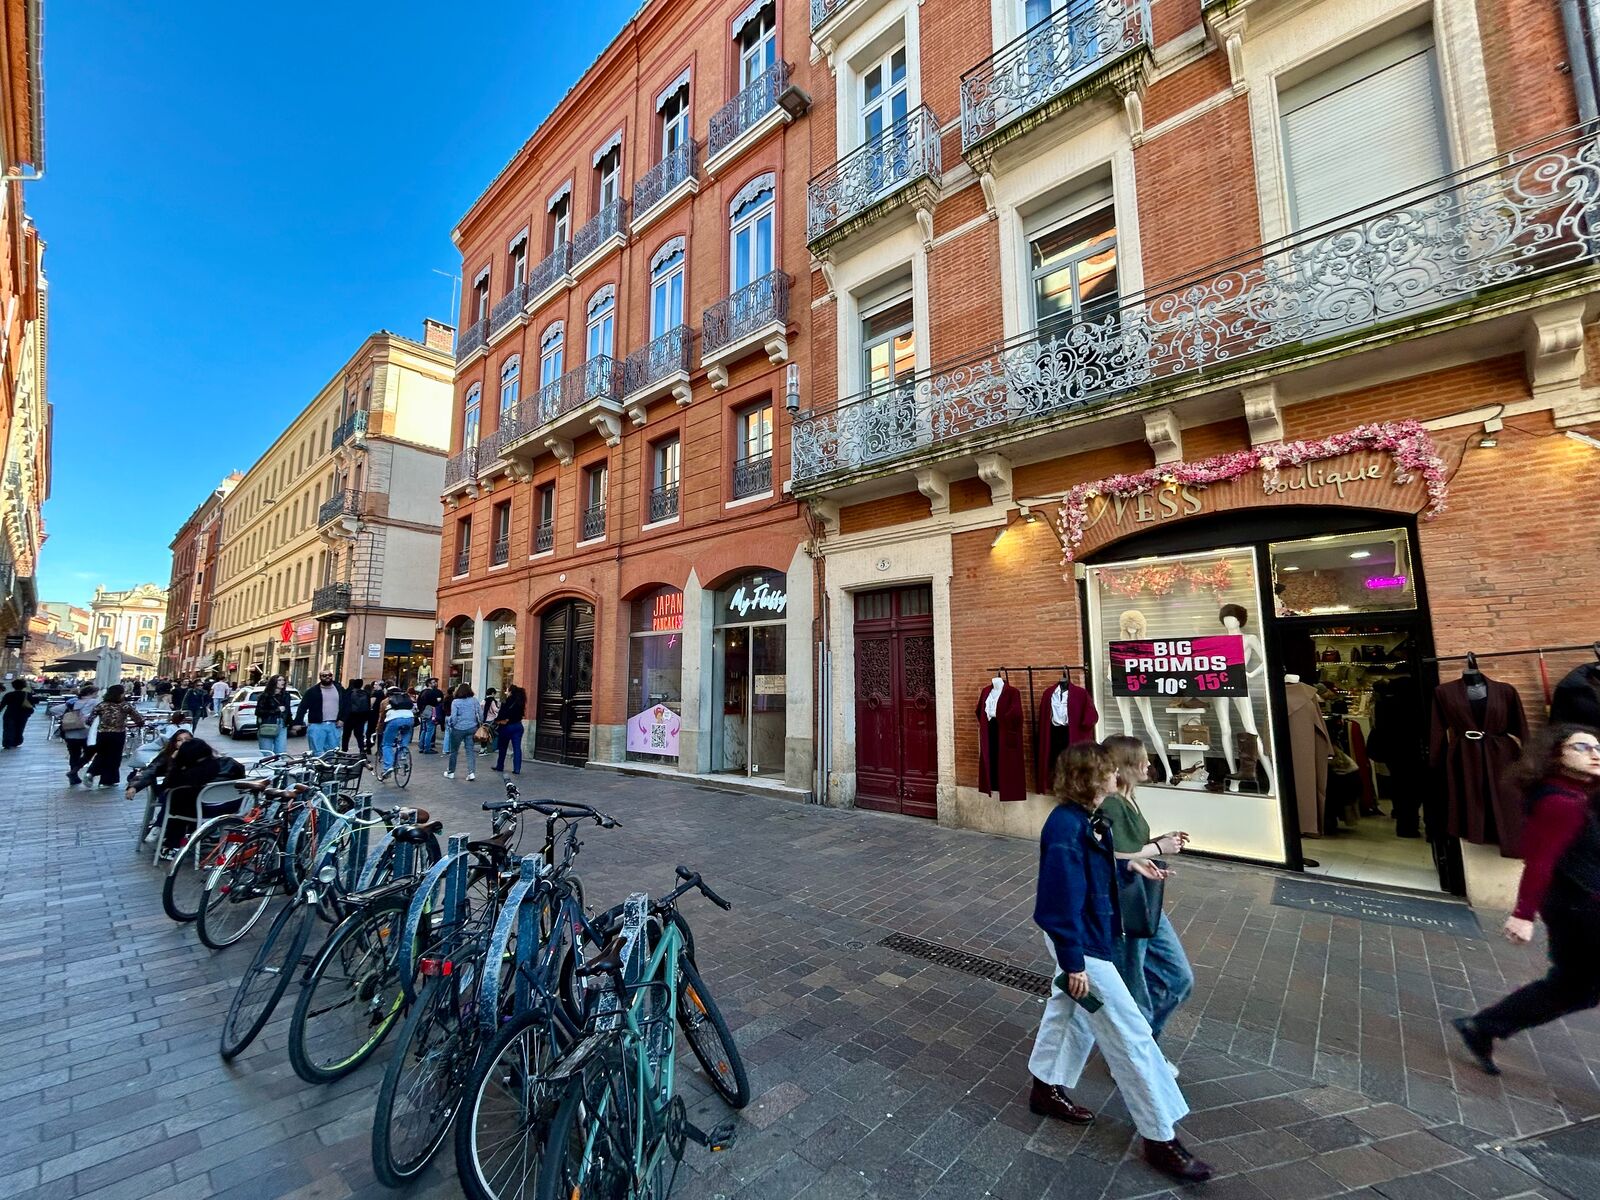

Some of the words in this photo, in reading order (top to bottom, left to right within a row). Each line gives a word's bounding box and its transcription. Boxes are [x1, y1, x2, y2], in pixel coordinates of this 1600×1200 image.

[1081, 487, 1202, 531] NESS
[653, 593, 683, 617] JAPAN
[730, 587, 750, 617] My
[750, 583, 787, 613] Fluffy
[652, 615, 683, 632] PANCAKES
[1153, 641, 1192, 656] BIG
[1125, 656, 1227, 673] PROMOS
[1127, 674, 1148, 691] 5€
[1155, 678, 1187, 694] 10€
